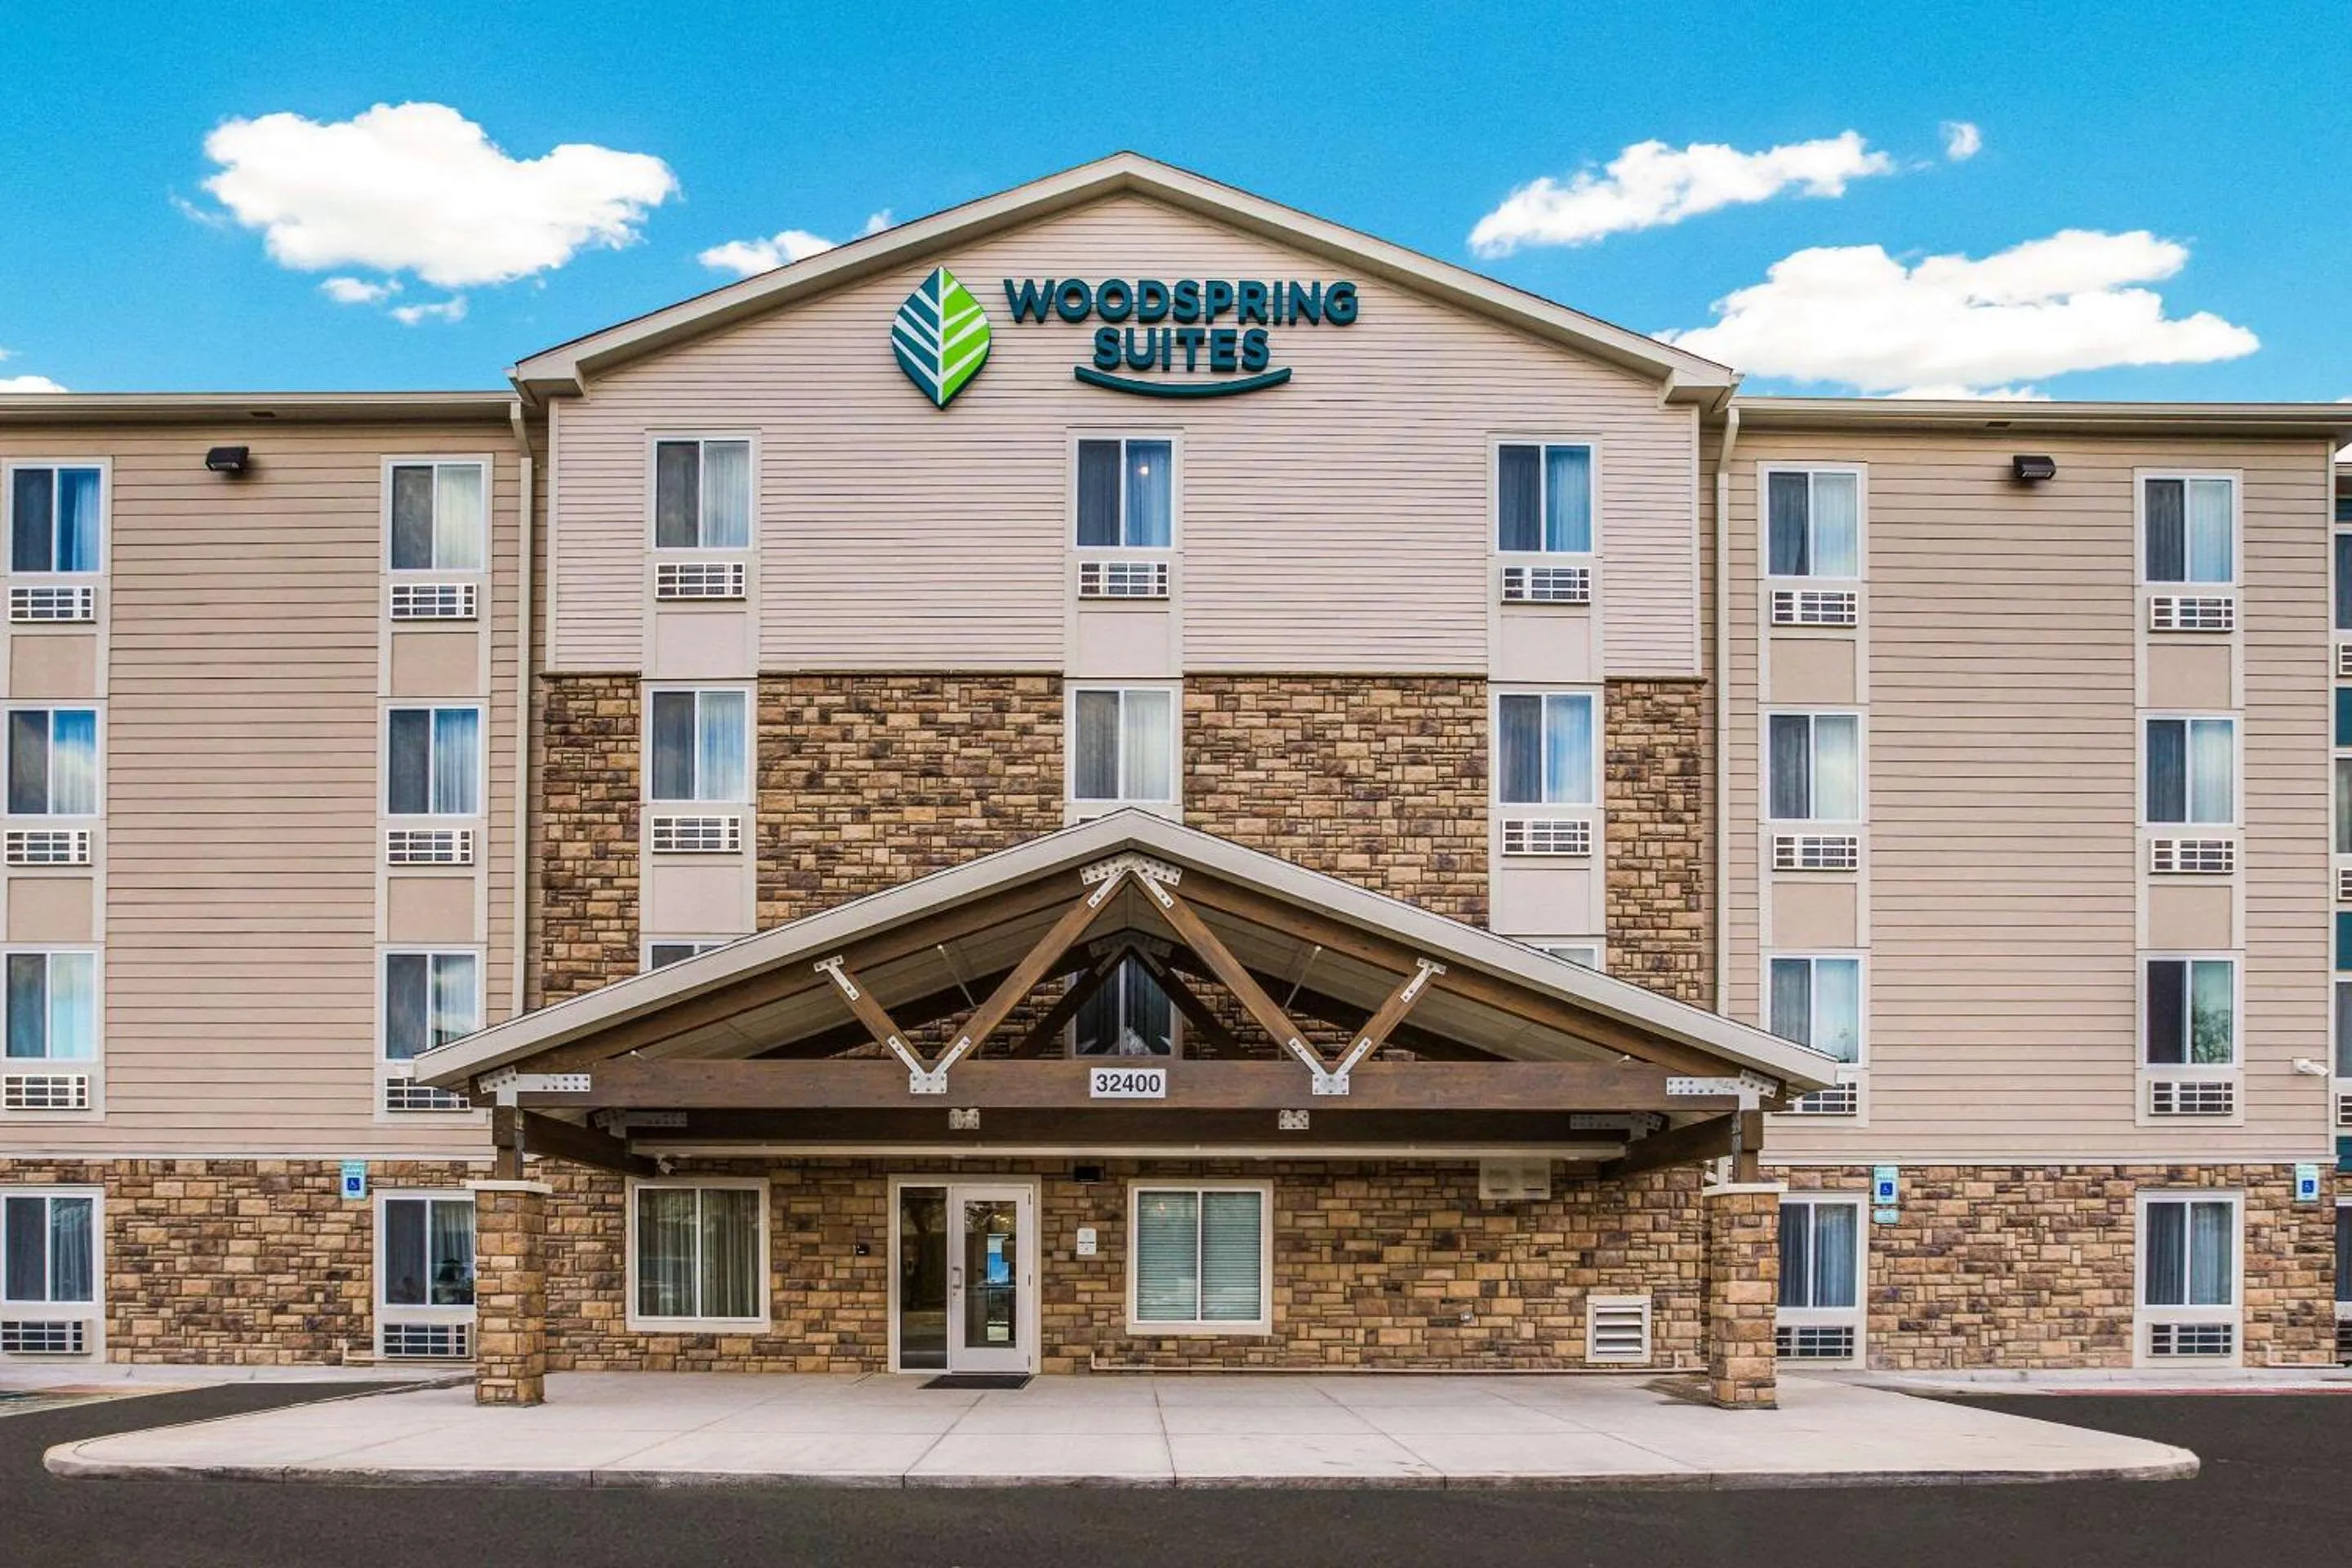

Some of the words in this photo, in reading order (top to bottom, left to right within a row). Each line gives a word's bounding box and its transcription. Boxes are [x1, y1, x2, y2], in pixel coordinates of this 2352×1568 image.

[1003, 278, 1358, 326] WOODSPRING
[1093, 327, 1271, 372] SUITES
[1096, 1074, 1160, 1092] 32400
